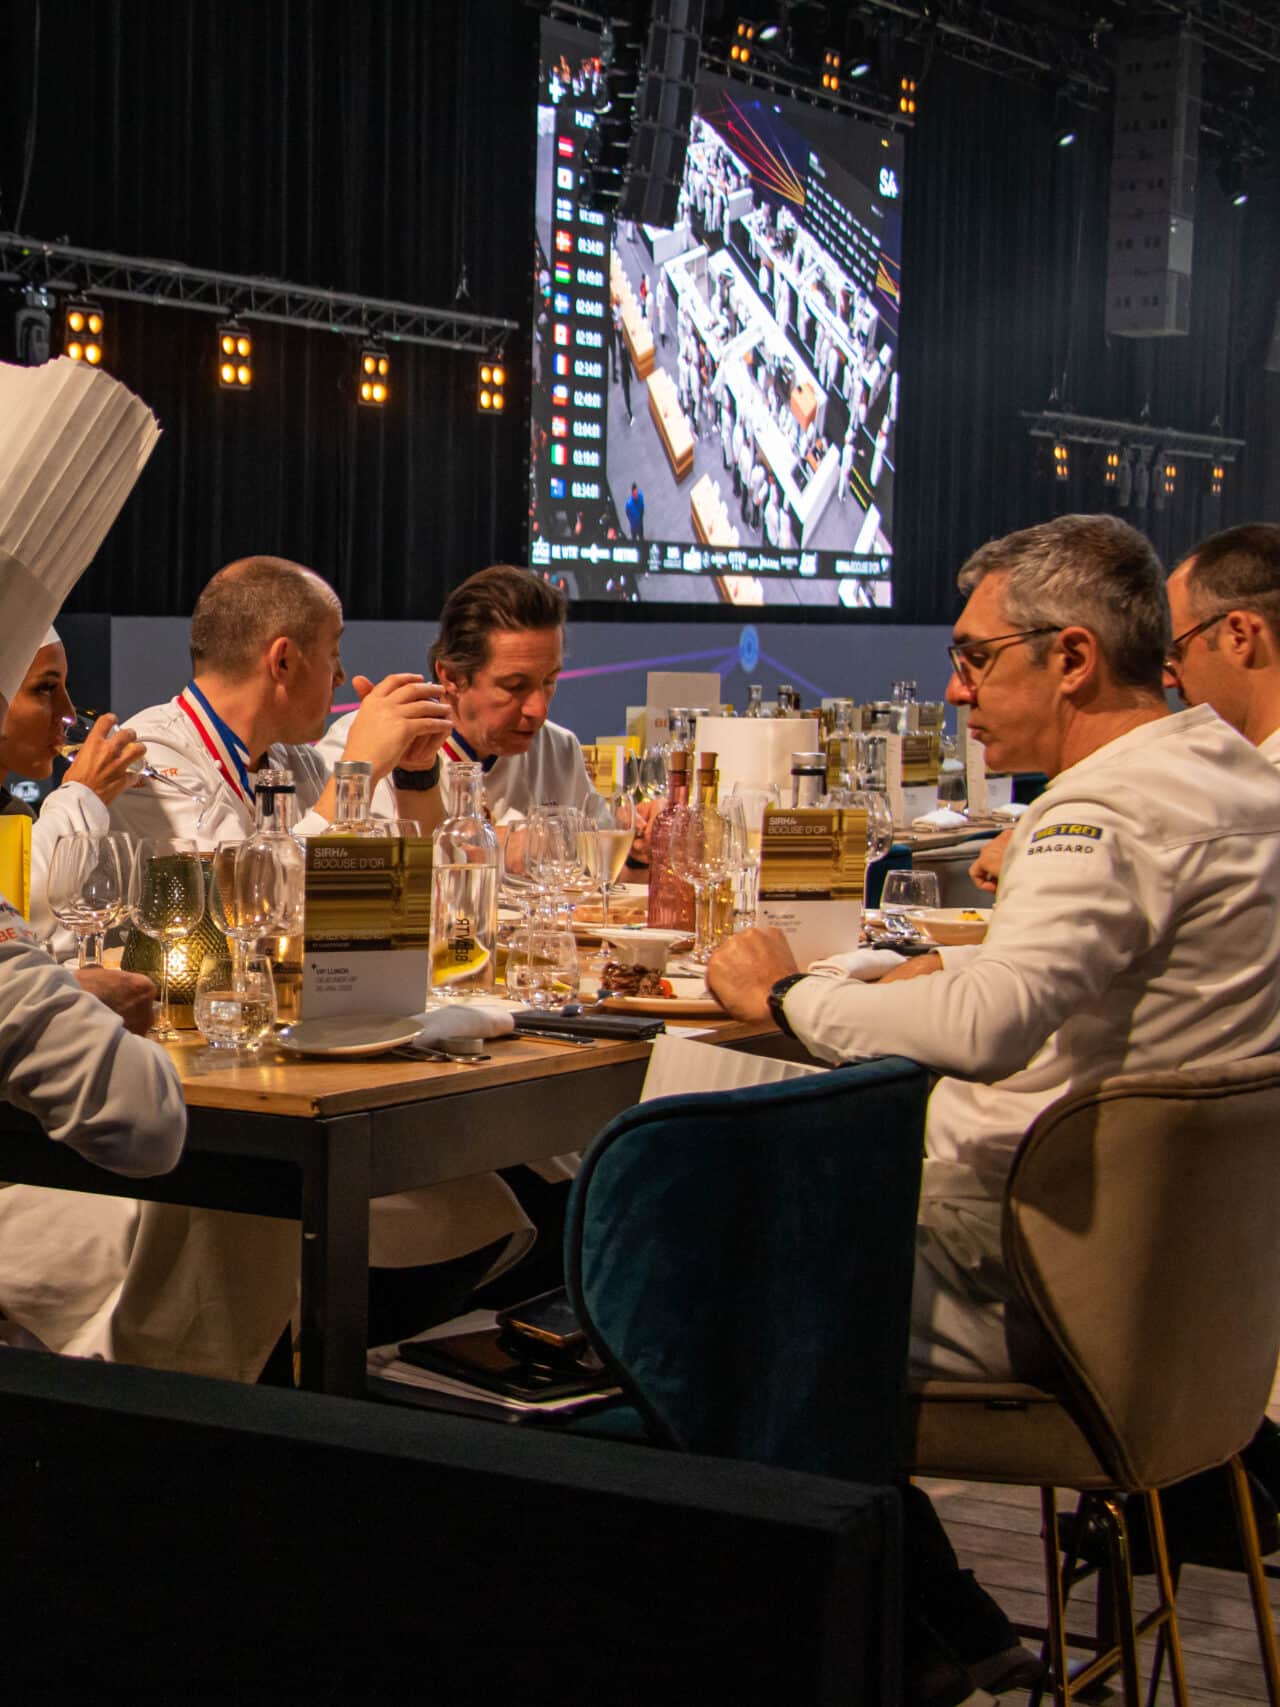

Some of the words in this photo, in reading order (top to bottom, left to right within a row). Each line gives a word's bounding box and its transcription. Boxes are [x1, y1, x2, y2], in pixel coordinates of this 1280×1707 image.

[1027, 844, 1094, 855] BRAGARD
[313, 858, 357, 869] BOCUSE
[360, 857, 384, 869] D'OR
